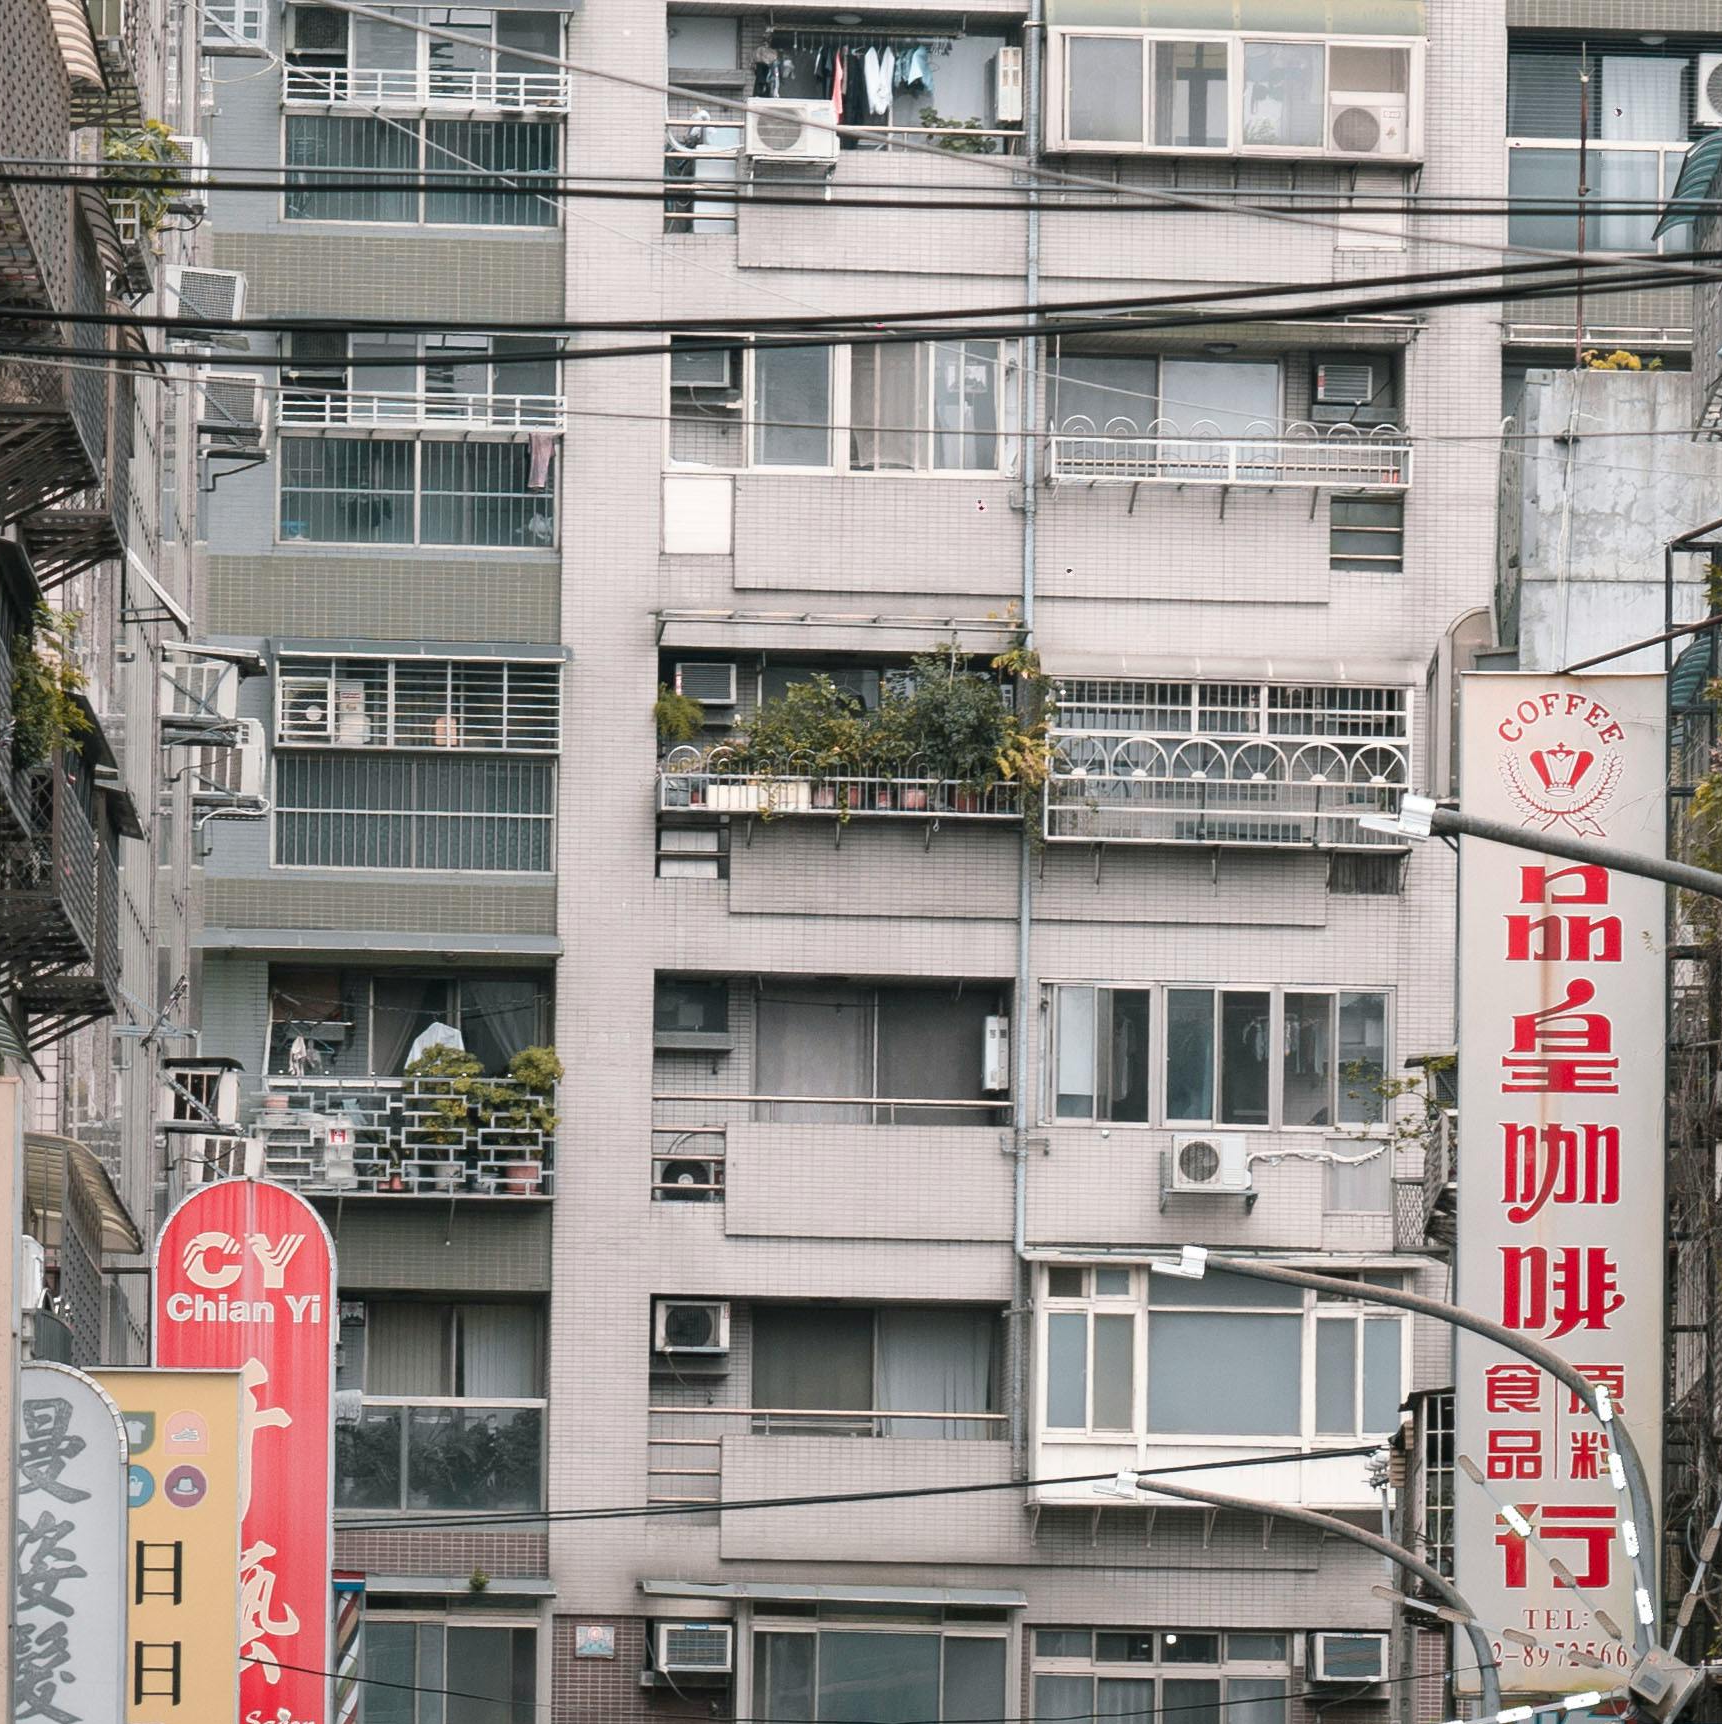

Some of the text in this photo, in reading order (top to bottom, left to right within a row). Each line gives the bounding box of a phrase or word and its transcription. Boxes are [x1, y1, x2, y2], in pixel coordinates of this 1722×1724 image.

[1498, 691, 1625, 745] COFFEE
[183, 1231, 306, 1289] CY
[166, 1293, 321, 1323] Chian Yi
[1484, 1364, 1543, 1480] 食品
[1523, 1608, 1589, 1631] TEL:
